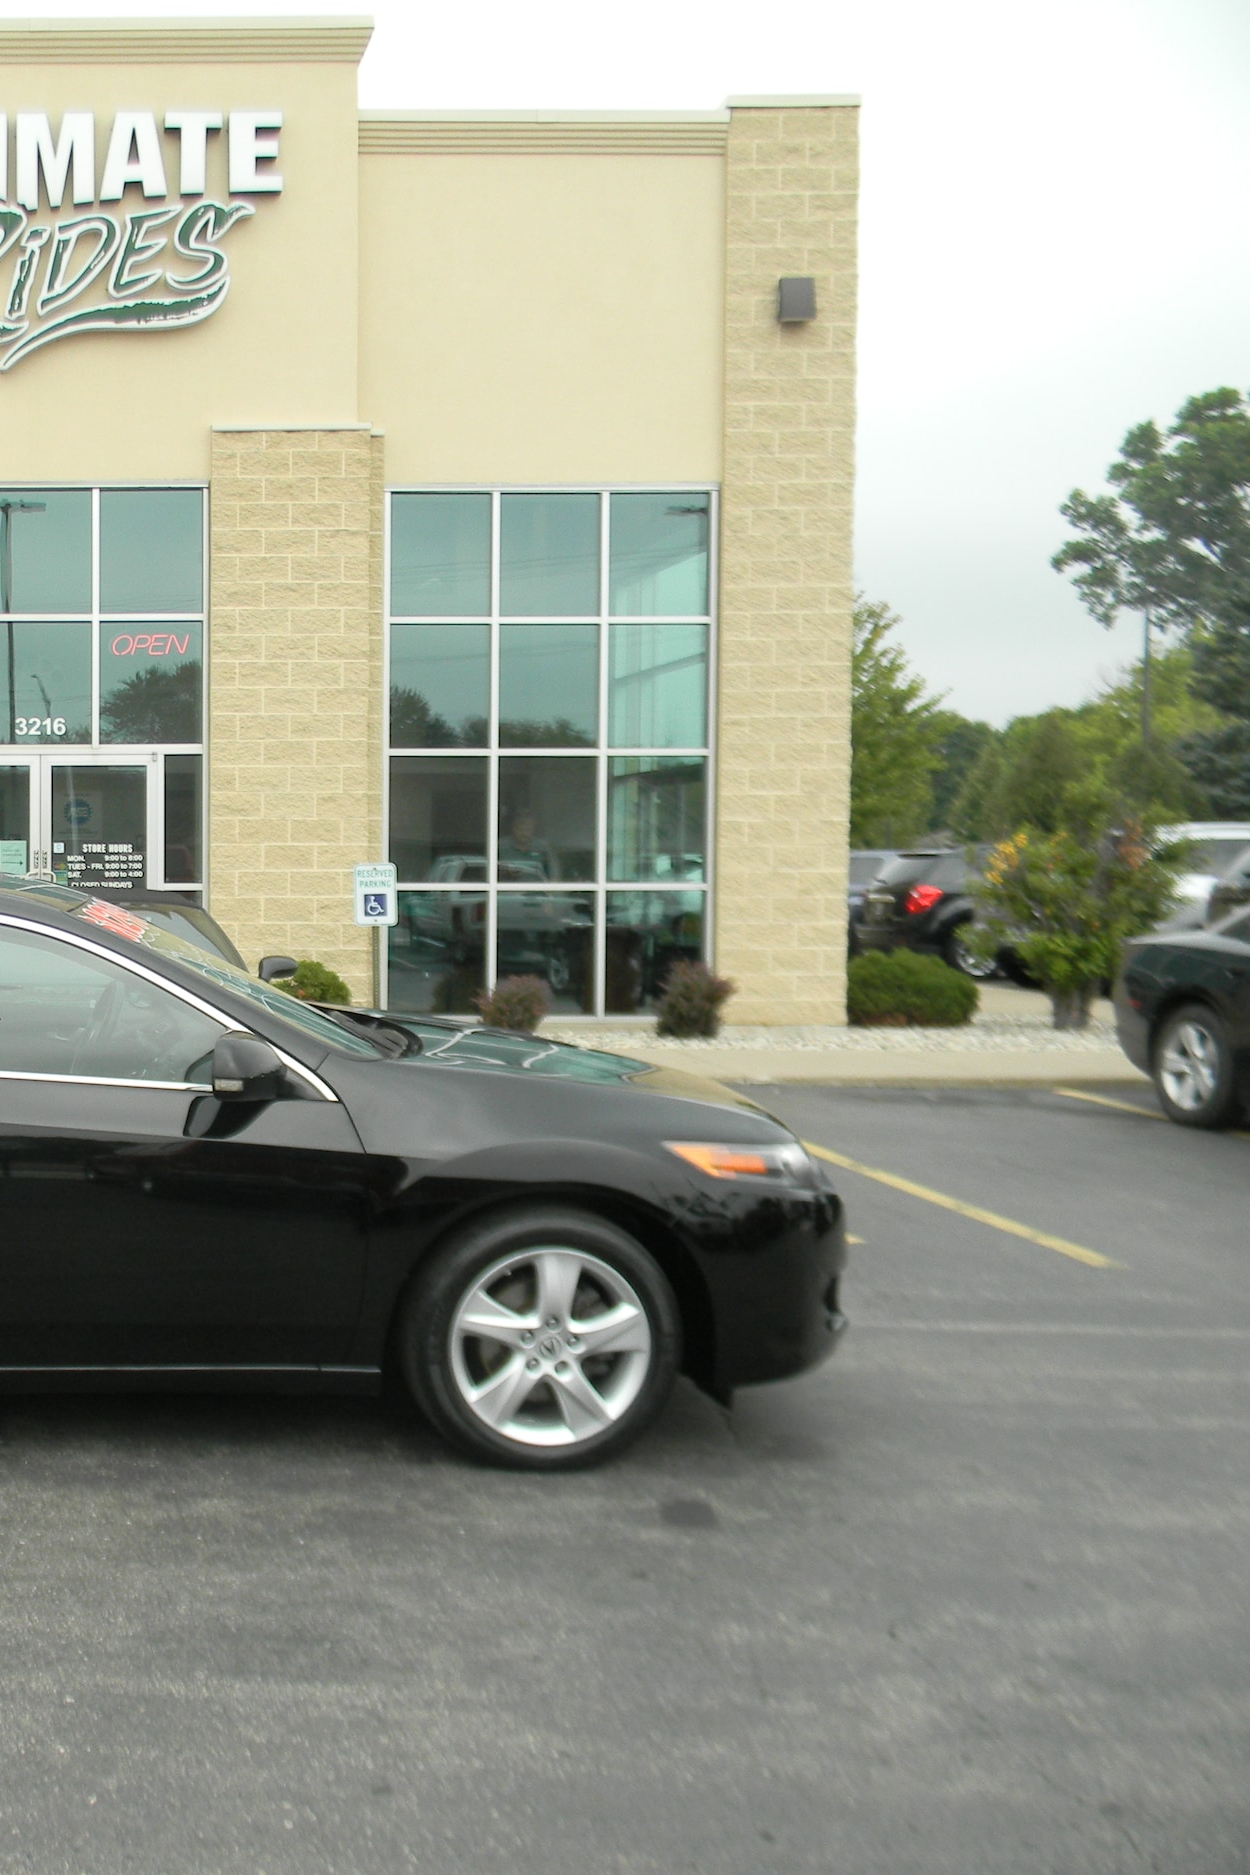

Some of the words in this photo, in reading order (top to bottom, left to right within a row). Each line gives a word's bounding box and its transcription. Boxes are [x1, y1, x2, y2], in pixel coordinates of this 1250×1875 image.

[111, 633, 190, 657] OPEN
[14, 717, 67, 737] 3216
[82, 843, 107, 854] STORE
[108, 843, 133, 854] HOURS
[357, 869, 394, 878] RESERVED
[101, 881, 133, 889] SUNDAYS
[359, 880, 392, 888] PARKING
